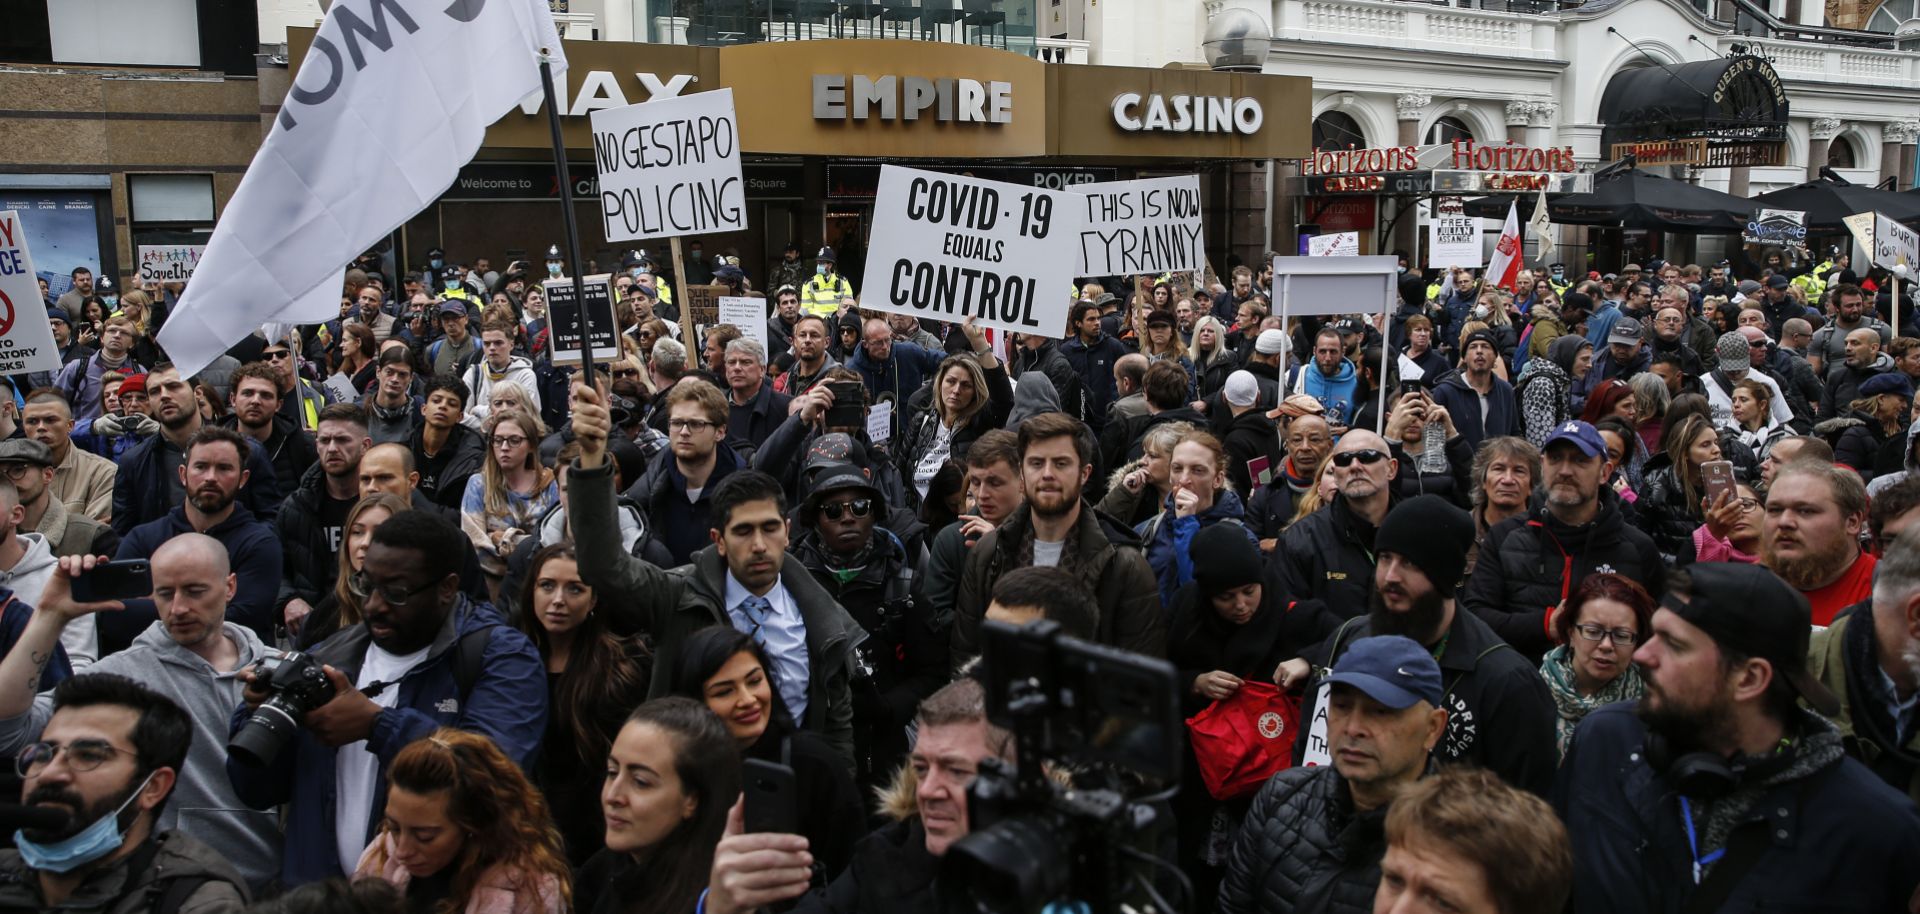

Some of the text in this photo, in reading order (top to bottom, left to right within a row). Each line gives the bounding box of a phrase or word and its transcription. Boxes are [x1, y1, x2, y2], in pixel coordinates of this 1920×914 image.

[1713, 59, 1785, 105] QUEEN'S HOUSE
[812, 75, 1011, 124] EMPIRE
[1111, 92, 1263, 134] CASINO
[594, 116, 733, 174] NO GESTAPO
[1302, 143, 1419, 176] Horizons
[1451, 137, 1577, 172] Horizons
[461, 178, 517, 189] Welcome
[518, 178, 532, 189] to
[749, 178, 787, 189] Square
[1324, 176, 1385, 192] CASINO
[1484, 174, 1549, 191] CASINO
[602, 176, 741, 238] POLICING
[907, 177, 999, 231] COVID
[1086, 187, 1200, 223] THIS IS NOW
[1439, 227, 1473, 235] JULIAN
[1440, 219, 1472, 227] FREE
[1890, 222, 1915, 250] BURN
[943, 232, 1005, 263] EQUALS
[1080, 223, 1202, 274] TYRANNY
[1876, 238, 1898, 257] YOUR
[890, 258, 1039, 327] CONTROL
